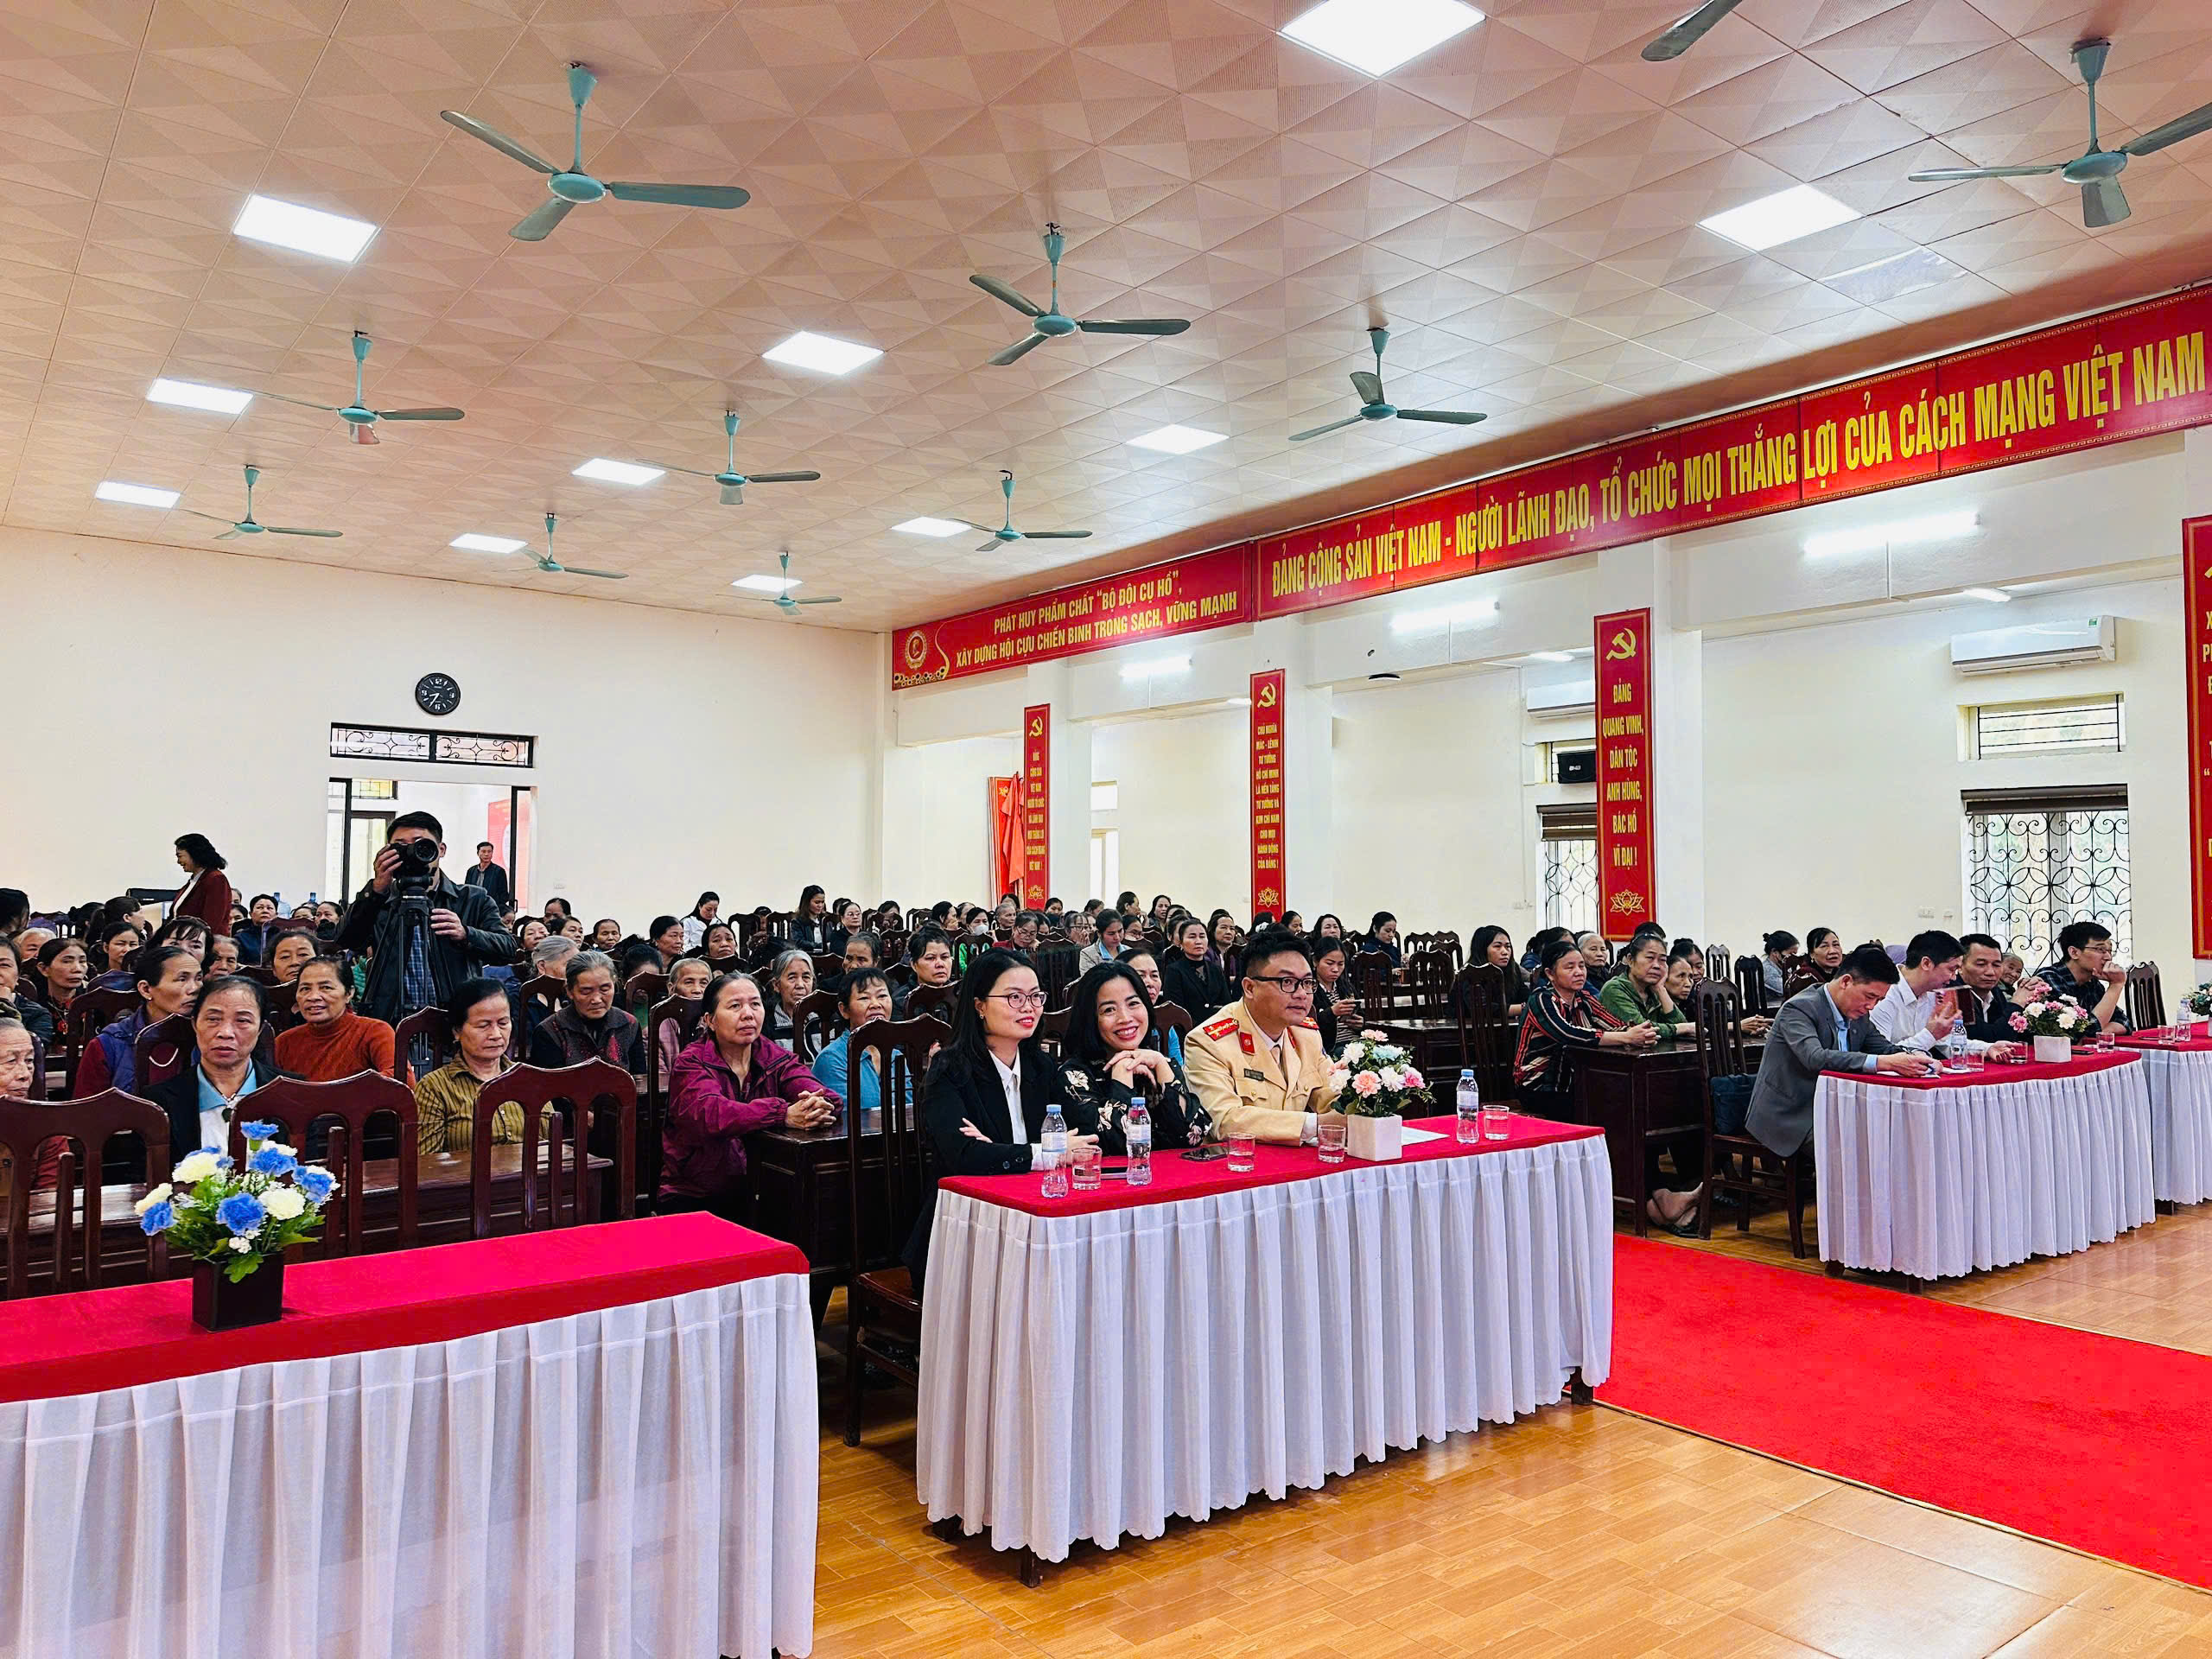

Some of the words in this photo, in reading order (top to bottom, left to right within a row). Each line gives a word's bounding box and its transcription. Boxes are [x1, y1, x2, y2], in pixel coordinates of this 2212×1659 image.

[1273, 543, 1305, 597] ĐẢNG
[1308, 542, 1342, 596] CỘNG
[1345, 525, 1373, 582] SẢN
[1376, 524, 1405, 581] VIỆT
[1408, 521, 1441, 567] NAM
[1455, 496, 1503, 556] NGƯỜI
[1508, 493, 1550, 545] LÃNH
[1555, 483, 1595, 542] ĐẠO,
[1599, 456, 1623, 524] TỔ
[1627, 458, 1678, 517] CHỨC
[1683, 451, 1721, 512] MỌI
[1727, 425, 1796, 498] THẮNG
[1802, 420, 1838, 488] LỢI
[1845, 391, 1892, 470] CỦA
[1900, 387, 1967, 459] CÁCH
[1974, 370, 2056, 448] MẠNG
[2063, 345, 2124, 429] VIỆT
[2133, 332, 2205, 405] NAM
[995, 613, 1016, 634] PHÁT
[1019, 610, 1037, 626] HUY
[1039, 598, 1066, 624] PHẨM
[1069, 591, 1094, 617] CHẤT
[1119, 582, 1137, 608] ĐỘI
[1140, 582, 1154, 603] CỤ
[956, 647, 973, 667] XÂY
[975, 643, 997, 668] DỰNG
[1000, 639, 1014, 660] HỘI
[1017, 635, 1034, 657] CỰU
[1037, 626, 1065, 650] CHIẾN
[1068, 626, 1091, 644] BINH
[1094, 615, 1128, 639] TRONG
[1131, 608, 1163, 633] SẠCH,
[1166, 601, 1197, 624] VỮNG
[1200, 591, 1237, 620] MẠNH
[1613, 678, 1631, 703] ĐẢNG
[1603, 717, 1624, 738] QUANG
[1626, 715, 1643, 734] VINH,
[1610, 746, 1623, 769] DÂN
[1624, 745, 1637, 771] TỘC
[1607, 783, 1621, 802] ANH
[1622, 778, 1642, 802] HÙNG,
[1612, 810, 1626, 833] BÁC
[1628, 809, 1637, 833] HỒ
[1622, 847, 1633, 869] ĐẠI
